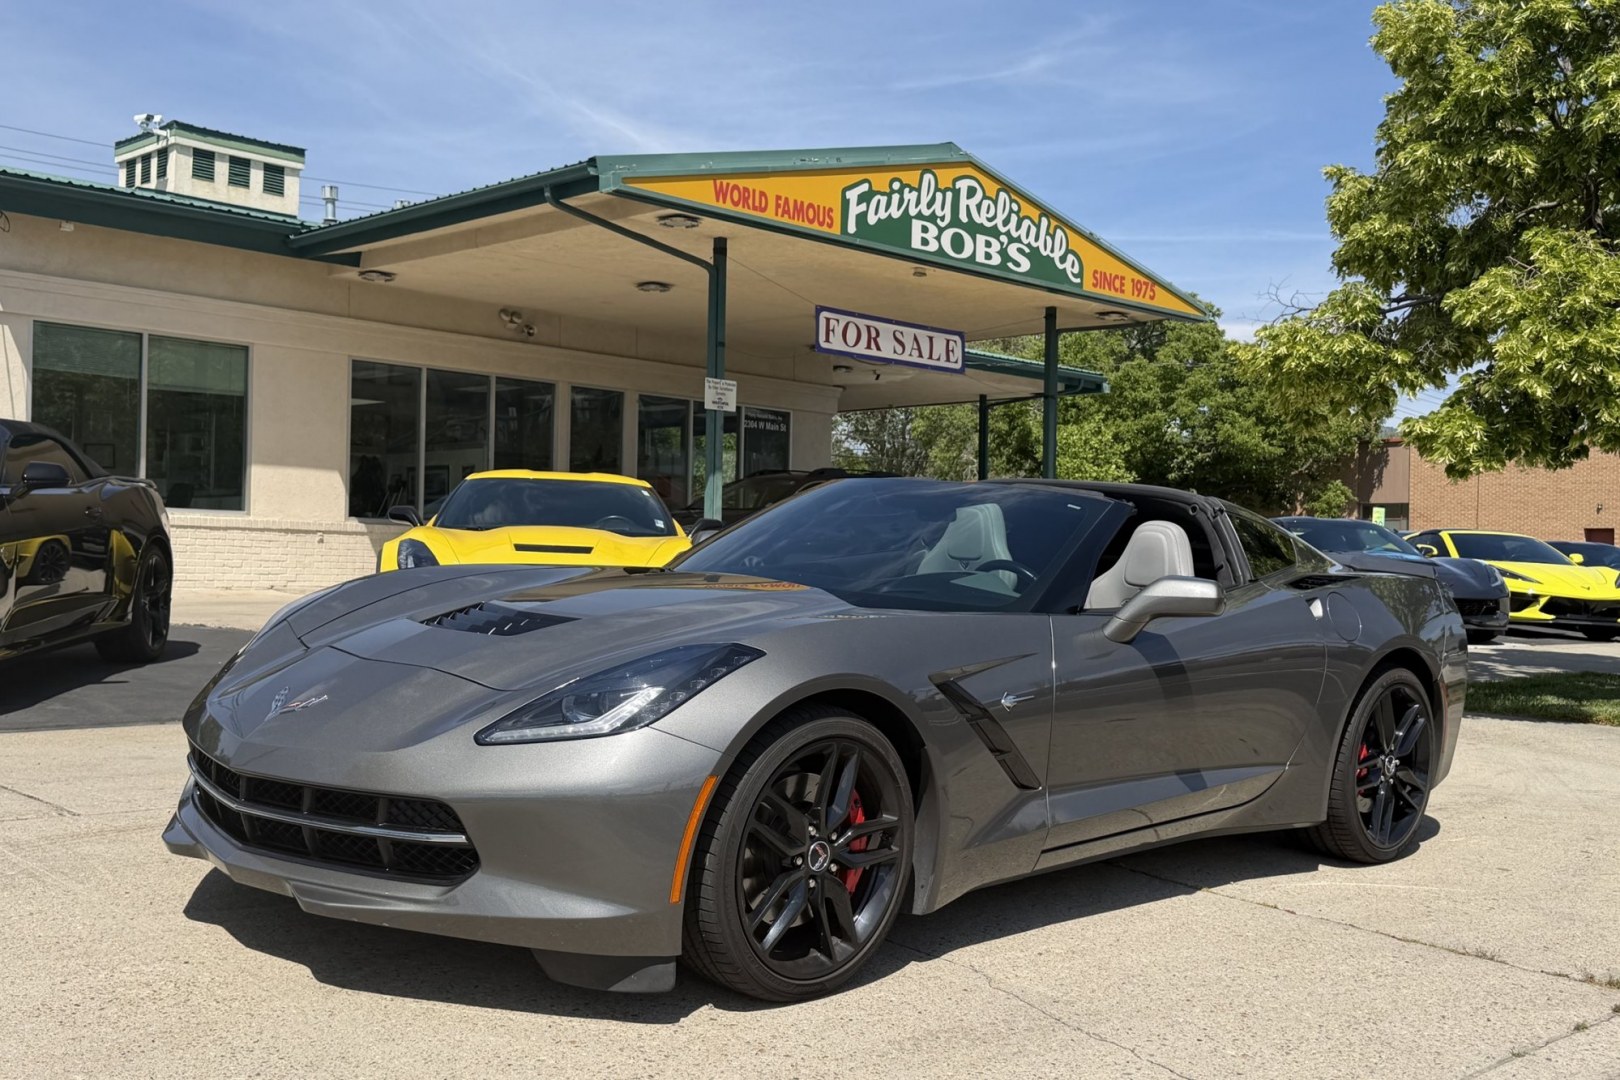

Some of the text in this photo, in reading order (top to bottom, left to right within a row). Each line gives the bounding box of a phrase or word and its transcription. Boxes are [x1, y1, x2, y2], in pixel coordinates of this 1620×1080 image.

[713, 179, 834, 229] WORLD FAMOUS
[845, 172, 1081, 284] Fairly Reliable
[911, 218, 1031, 273] BOB'S
[1092, 269, 1156, 301] SINCE 1975
[823, 316, 960, 364] FOR SALE
[744, 420, 787, 432] 2304 W Main St
